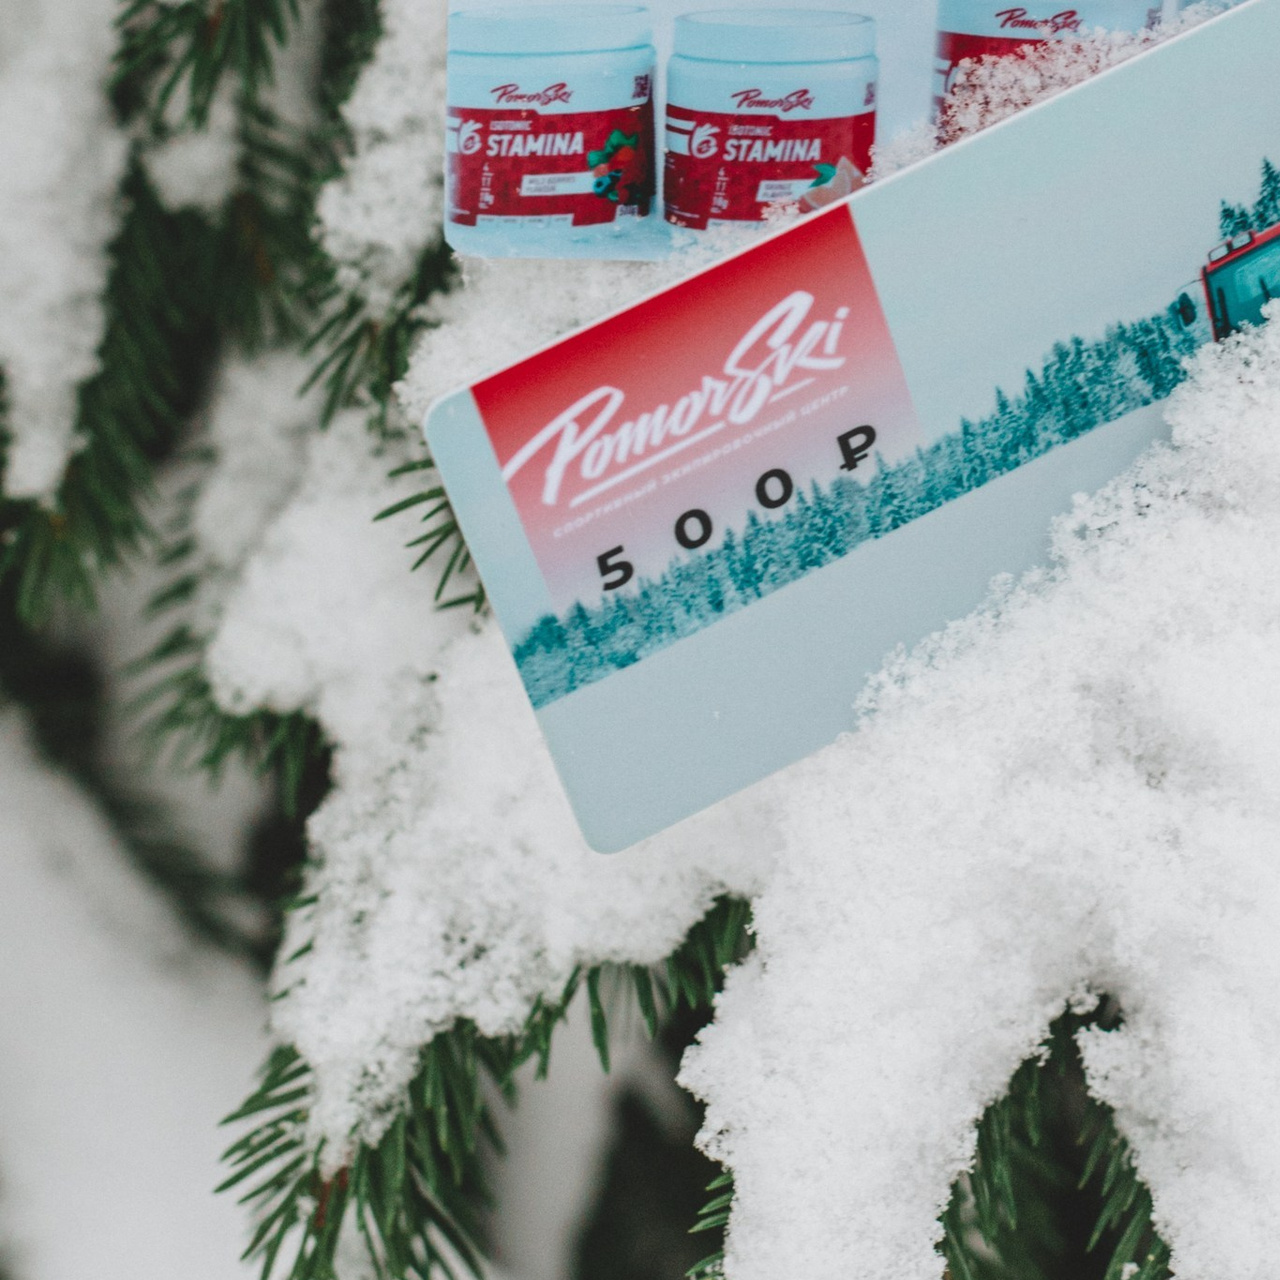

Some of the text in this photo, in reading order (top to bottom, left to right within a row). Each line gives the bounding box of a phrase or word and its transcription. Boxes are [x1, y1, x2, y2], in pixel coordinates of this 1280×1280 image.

[486, 132, 584, 157] STAMINA
[723, 138, 822, 162] STAMINA
[501, 290, 850, 506] PomorSki
